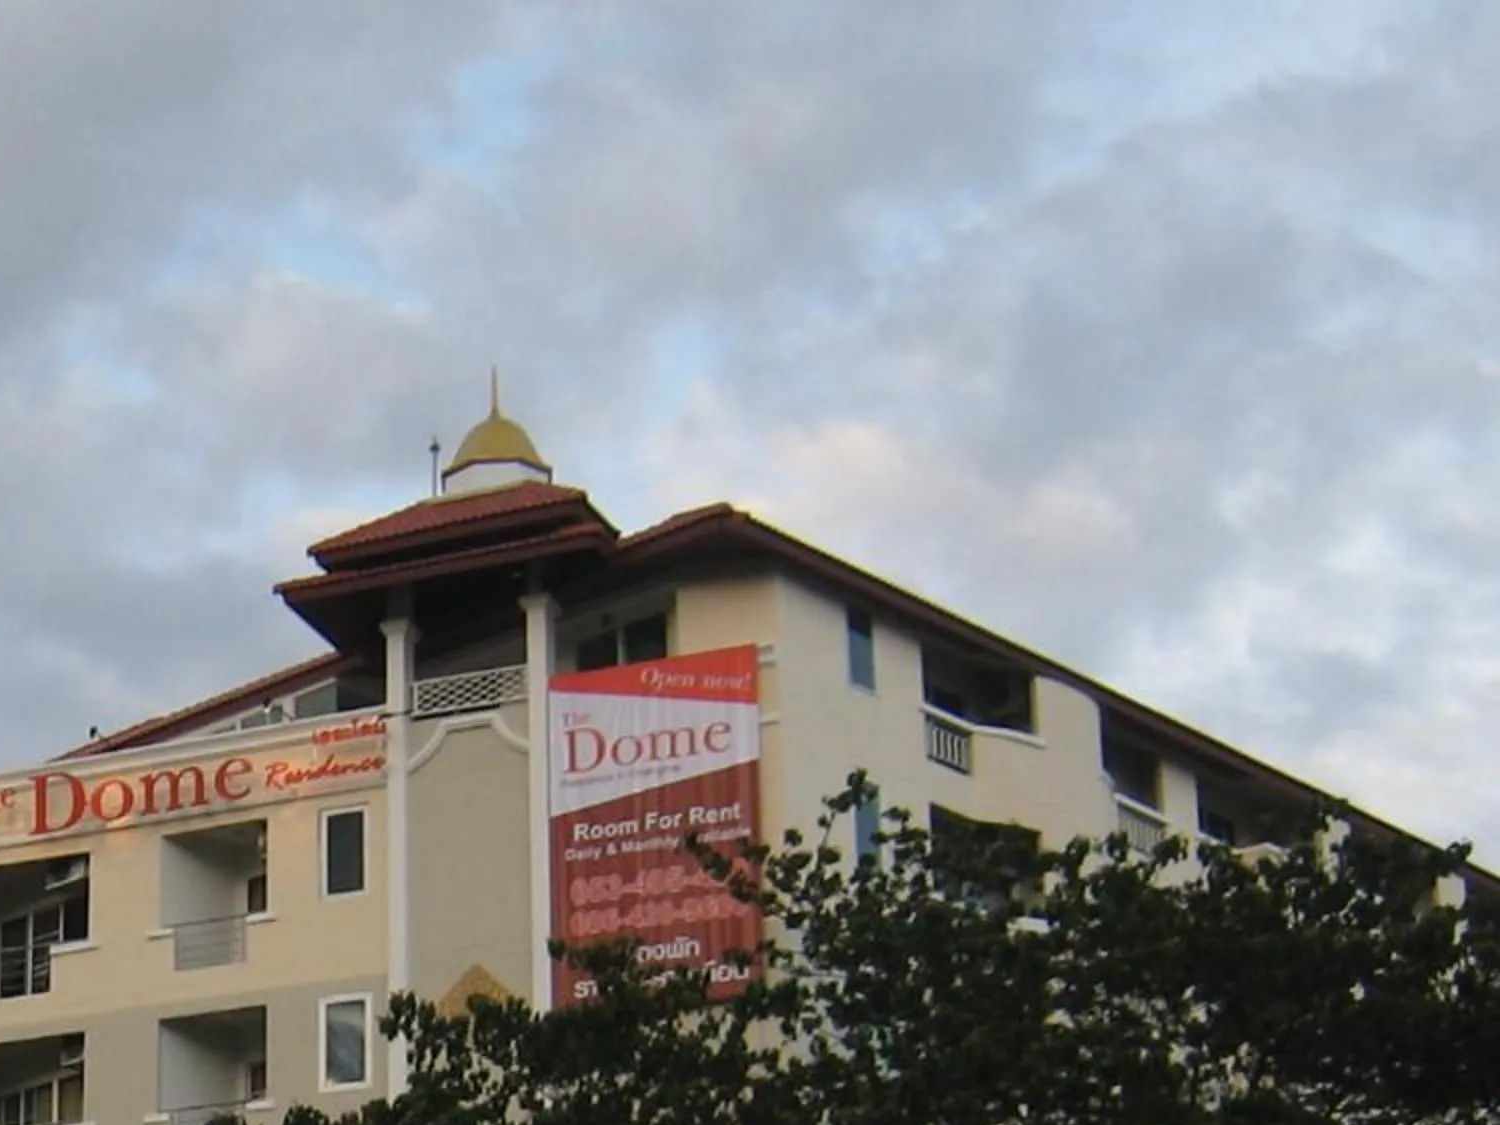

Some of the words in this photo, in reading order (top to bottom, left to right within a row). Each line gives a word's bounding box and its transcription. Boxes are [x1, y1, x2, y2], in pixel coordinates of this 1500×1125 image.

[640, 666, 694, 692] Open
[564, 720, 733, 774] Dome
[27, 757, 254, 836] Dome
[265, 754, 386, 790] Residence
[573, 818, 639, 842] Room
[645, 811, 683, 830] For
[689, 803, 741, 824] Rent
